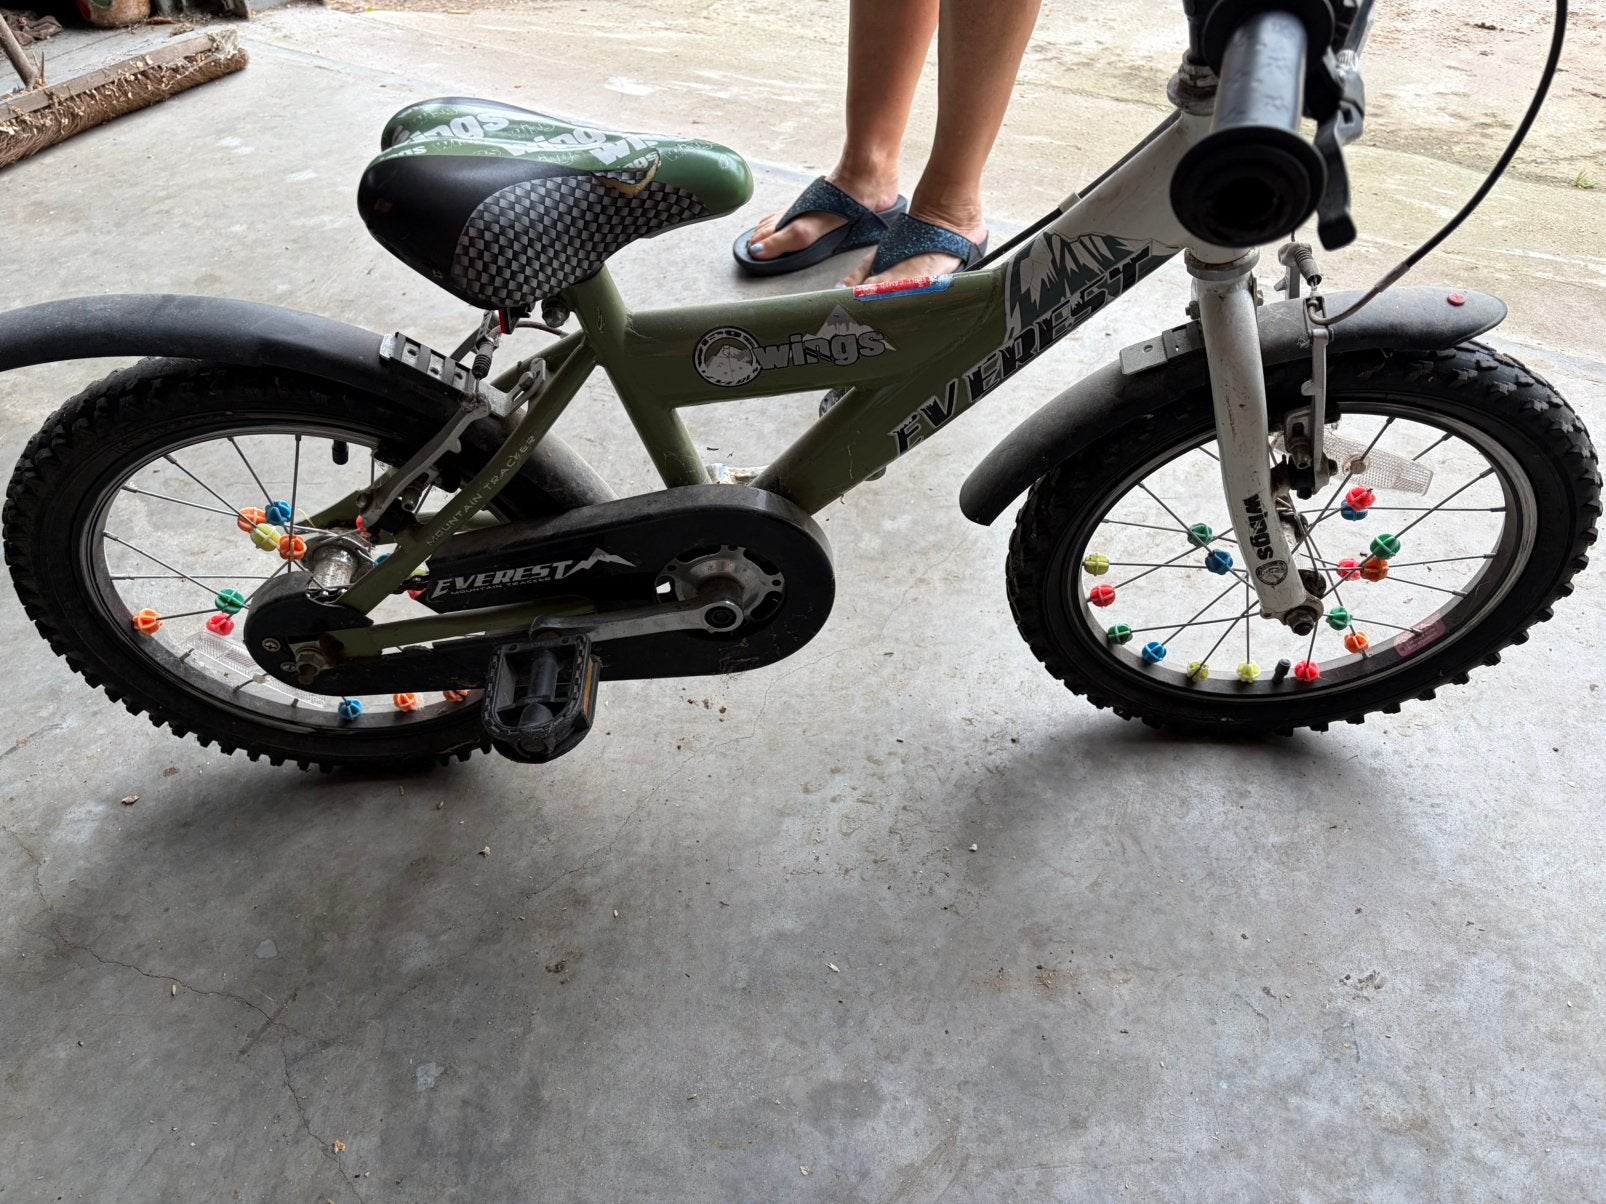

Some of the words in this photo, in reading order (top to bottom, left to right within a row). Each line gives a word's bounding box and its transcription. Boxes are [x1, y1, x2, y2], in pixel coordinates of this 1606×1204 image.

[752, 329, 886, 371] wings
[887, 245, 1151, 457] EVEREST
[426, 492, 484, 546] MOUNTAIN
[483, 435, 536, 491] TRACKER
[1242, 493, 1274, 561] wings
[430, 559, 574, 600] EVEREST
[450, 584, 503, 596] MOUNTAIN
[506, 576, 552, 588] TRACKER
